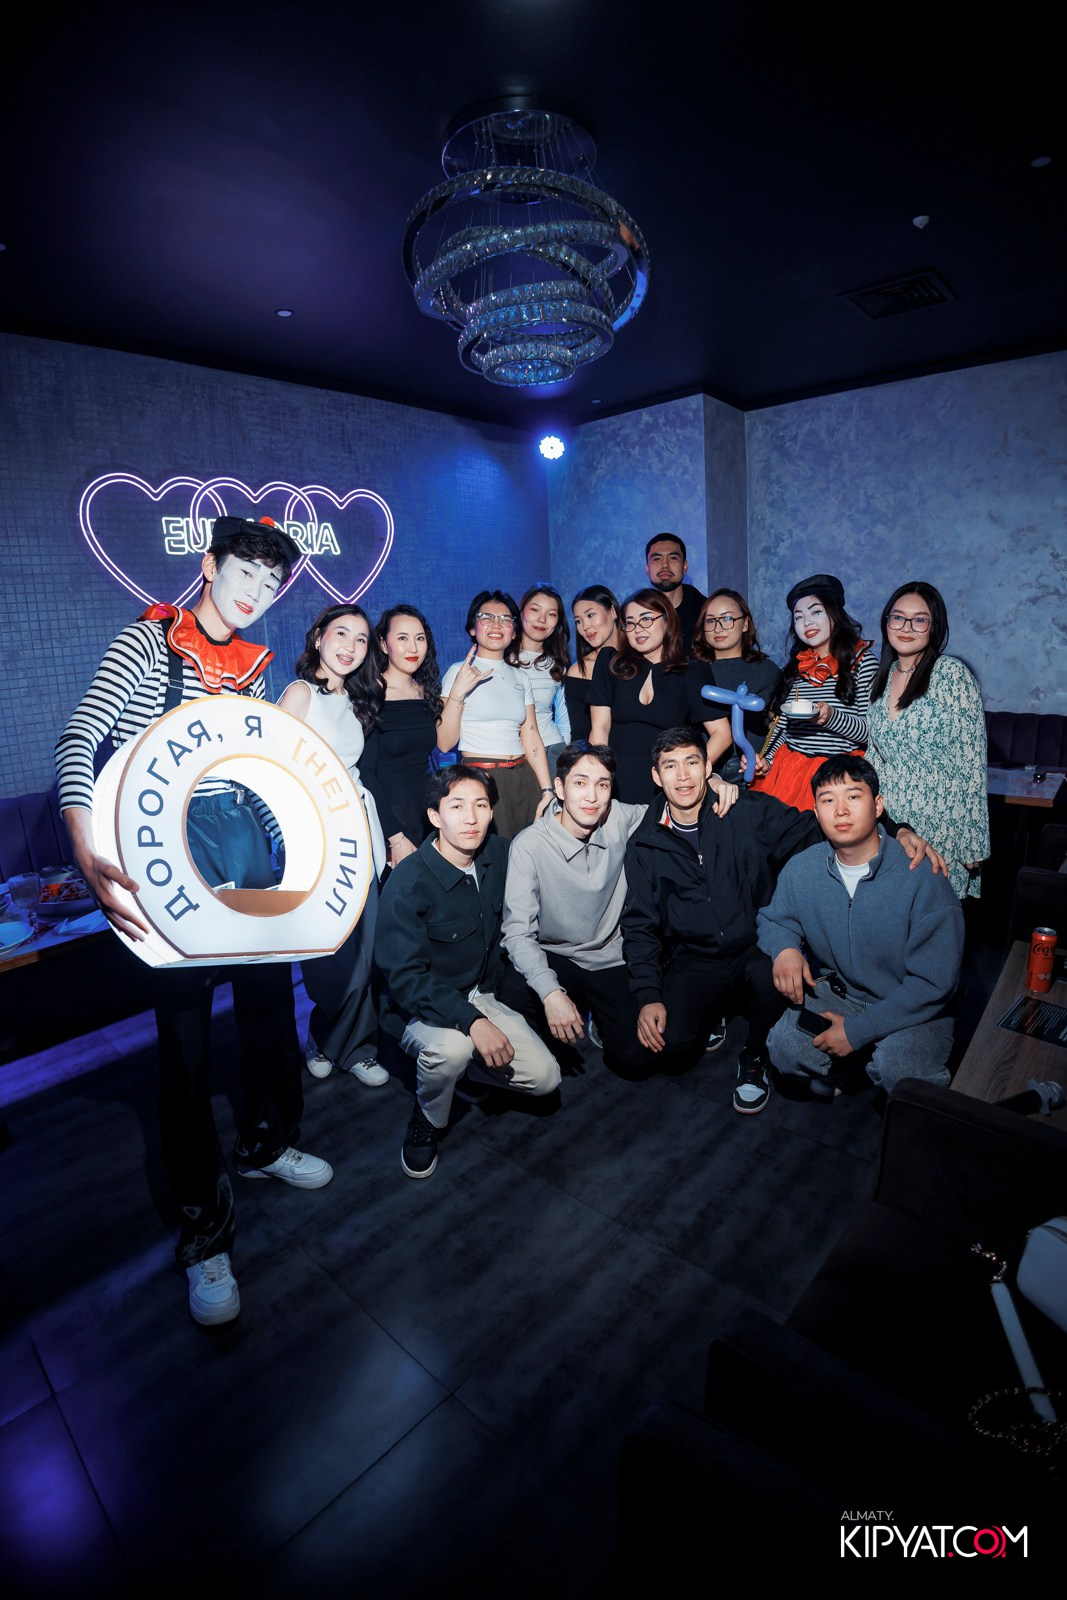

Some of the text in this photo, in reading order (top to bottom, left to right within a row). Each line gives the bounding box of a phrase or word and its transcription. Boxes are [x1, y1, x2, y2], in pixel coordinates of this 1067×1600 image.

[162, 516, 341, 555] EURIA
[137, 719, 224, 922] ДОРОГАЯ,
[244, 715, 263, 739] Я
[325, 837, 358, 917] ПИЛ
